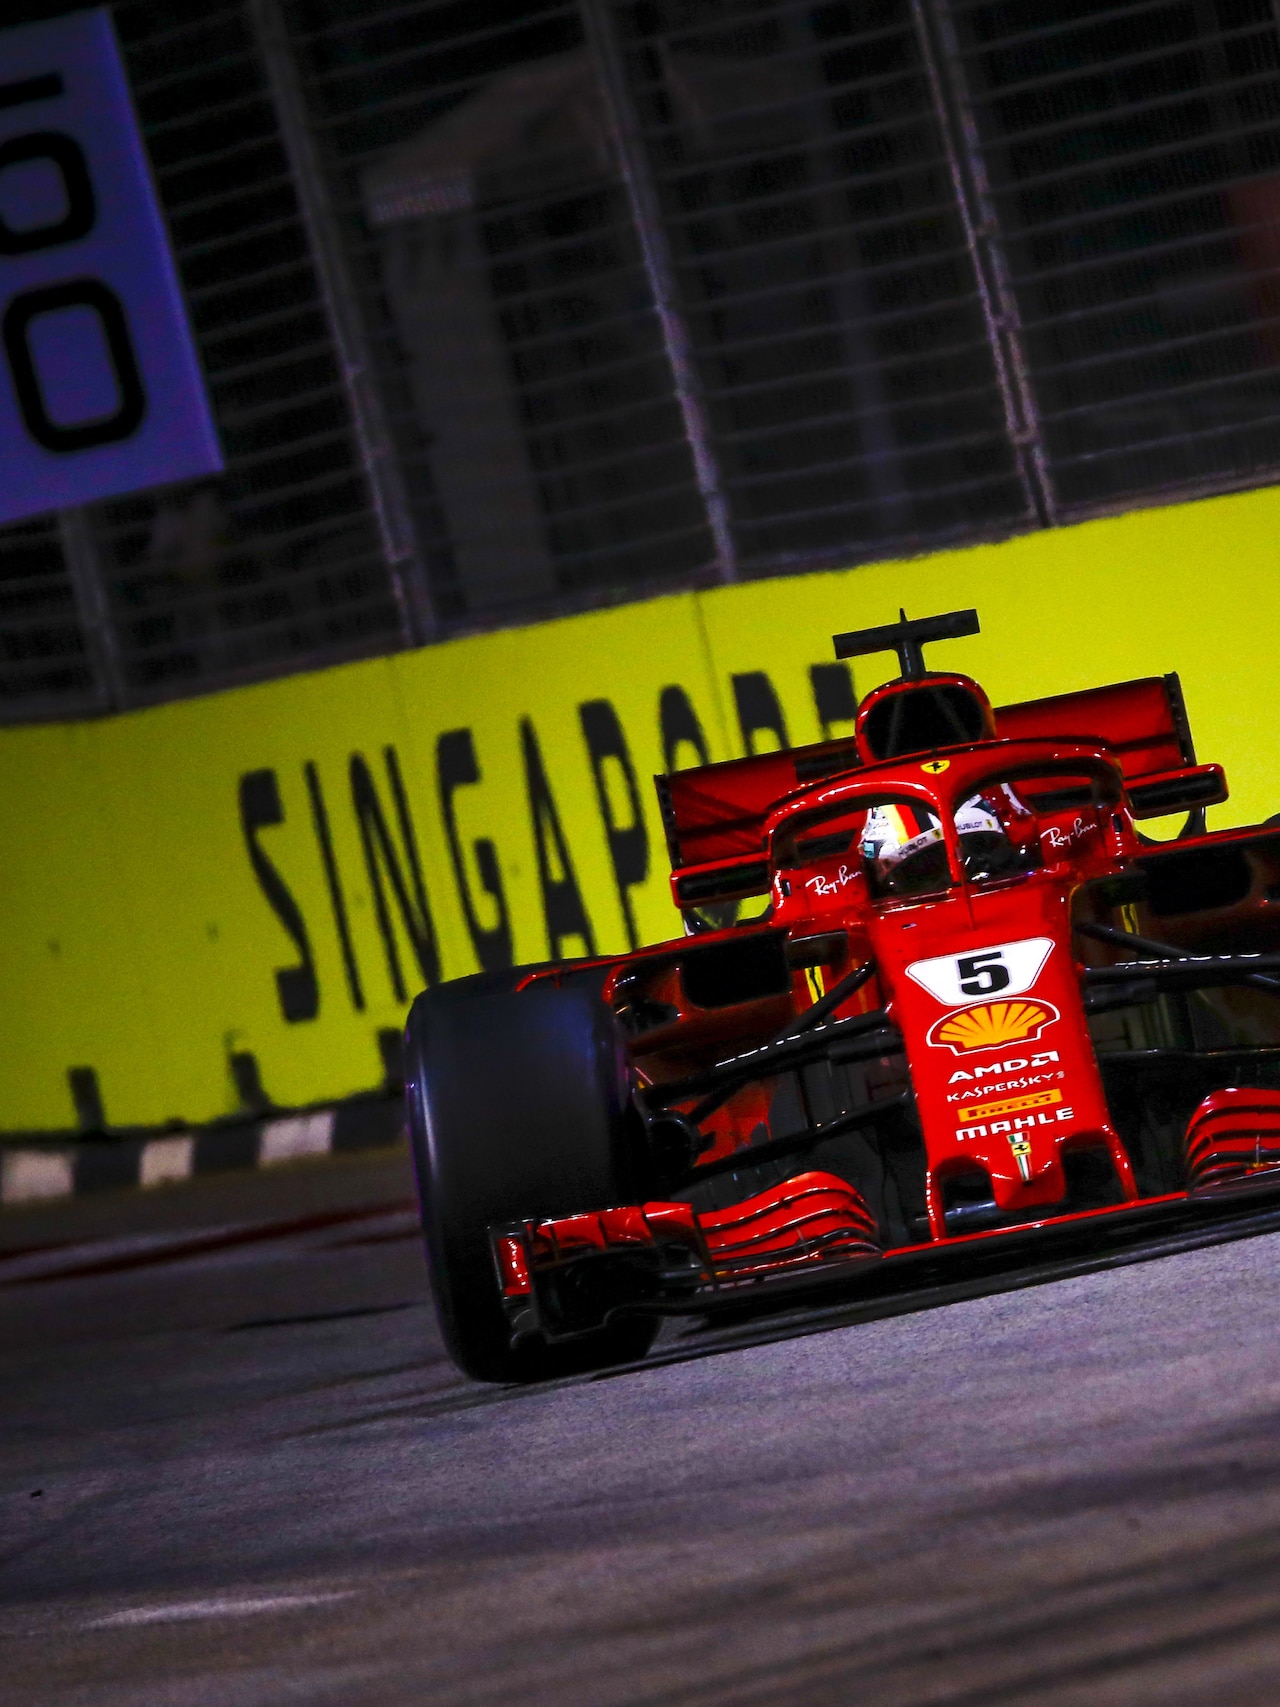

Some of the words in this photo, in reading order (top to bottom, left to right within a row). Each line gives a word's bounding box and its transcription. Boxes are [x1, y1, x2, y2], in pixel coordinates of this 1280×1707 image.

[238, 663, 857, 1024] SINGAP
[1040, 817, 1097, 848] Ray-Ban
[957, 951, 1010, 996] 5
[948, 1056, 1031, 1084] AMD
[946, 1073, 1053, 1102] KASPERSKY
[955, 1107, 1074, 1141] MAHLE
